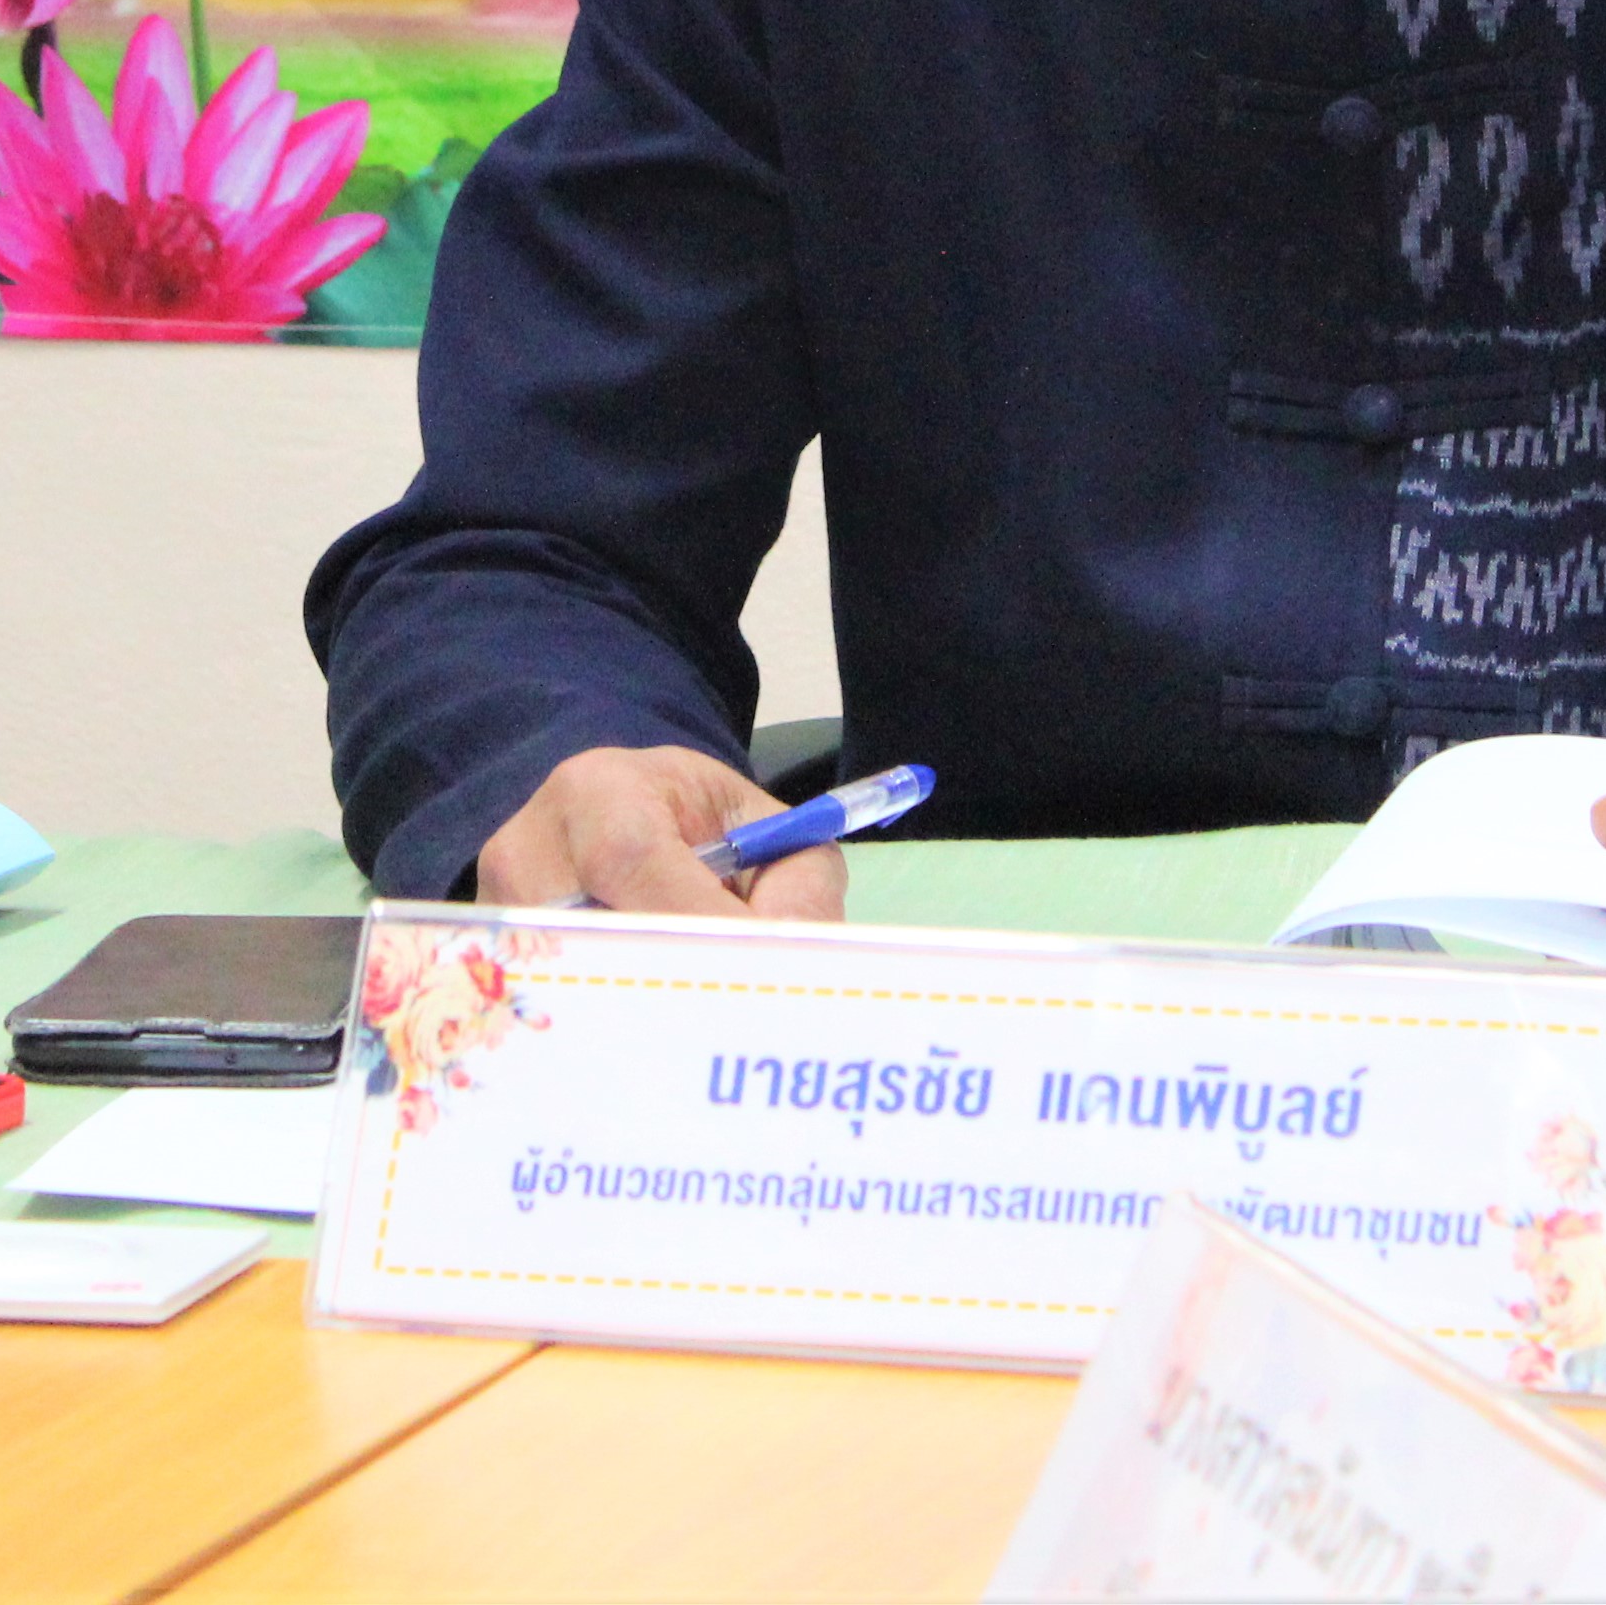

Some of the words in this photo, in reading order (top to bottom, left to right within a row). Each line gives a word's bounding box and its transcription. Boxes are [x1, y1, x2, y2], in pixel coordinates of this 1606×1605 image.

[706, 1046, 994, 1139] นายสุรชัย
[510, 1147, 1484, 1261] ผู้อำนวยการกลุ่มงานสารสนเทศกพัฒนาชุมชน
